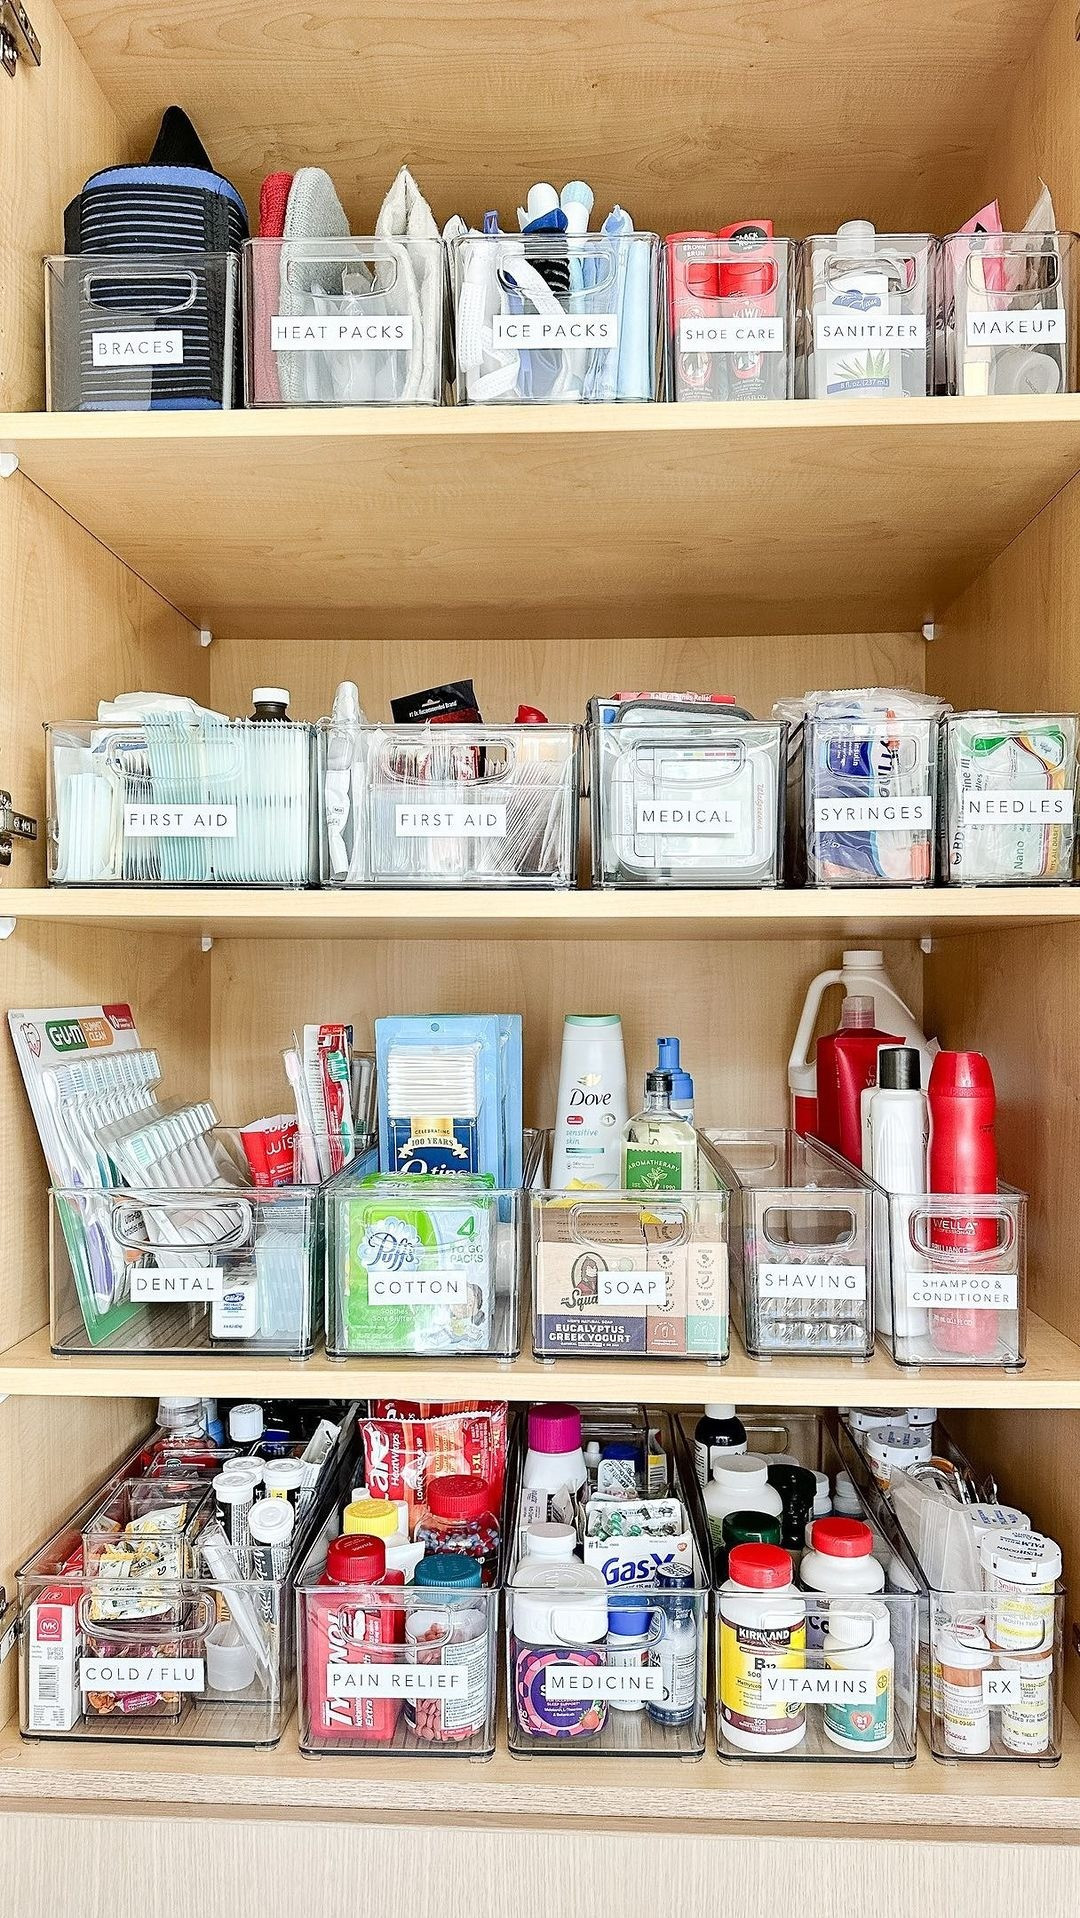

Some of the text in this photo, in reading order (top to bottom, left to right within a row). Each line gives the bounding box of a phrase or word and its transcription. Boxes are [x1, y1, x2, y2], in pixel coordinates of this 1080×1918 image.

[277, 325, 404, 339] HEAT PACKS
[498, 323, 608, 338] ICE PACKS
[685, 328, 775, 340] SHOE CARE
[823, 325, 918, 338] SANITIZER
[972, 319, 1057, 335] MAKEUP
[98, 340, 174, 355] BRACES
[975, 774, 983, 791] dles
[820, 805, 923, 821] SYRINGES
[969, 799, 1064, 814] NEEDLES
[129, 813, 228, 827] FIRST AID
[400, 813, 498, 827] FIRST AID
[642, 809, 733, 823] MEDICAL
[1014, 841, 1024, 870] Nano
[570, 1088, 612, 1106] Dove
[263, 1119, 298, 1134] Colga
[266, 1130, 294, 1155] wis
[426, 1138, 454, 1147] YEARS
[400, 1158, 470, 1174] Qti
[628, 1160, 680, 1172] AROMATHERAPY
[456, 1215, 476, 1242] 4
[932, 1218, 976, 1231] WELLA
[366, 1232, 415, 1272] Puffs
[450, 1254, 484, 1264] PACKS
[136, 1277, 215, 1291] DENTAL
[374, 1280, 458, 1295] COTTON
[603, 1281, 657, 1295] SOAP
[764, 1273, 856, 1289] SHAVING
[922, 1279, 1002, 1290] SHAMPOO &
[566, 1288, 598, 1312] Squa
[912, 1292, 1009, 1303] CONDITIONER
[556, 1324, 625, 1334] EUCALYPTUS
[549, 1333, 631, 1343] GREEK YOGURT
[391, 1433, 402, 1486] HeatWraps
[472, 1454, 481, 1474] L-XL
[42, 1622, 57, 1631] MK
[739, 1628, 790, 1642] KIRKLAND
[85, 1667, 195, 1681] COLD / FLU
[322, 1610, 354, 1727] TYNOL
[747, 1670, 762, 1678] 500
[332, 1673, 460, 1688] PAIN RELIEF
[551, 1676, 655, 1690] MEDICINE
[767, 1678, 868, 1694] VITAMINS
[988, 1680, 1012, 1694] RX
[874, 1721, 887, 1730] 400
